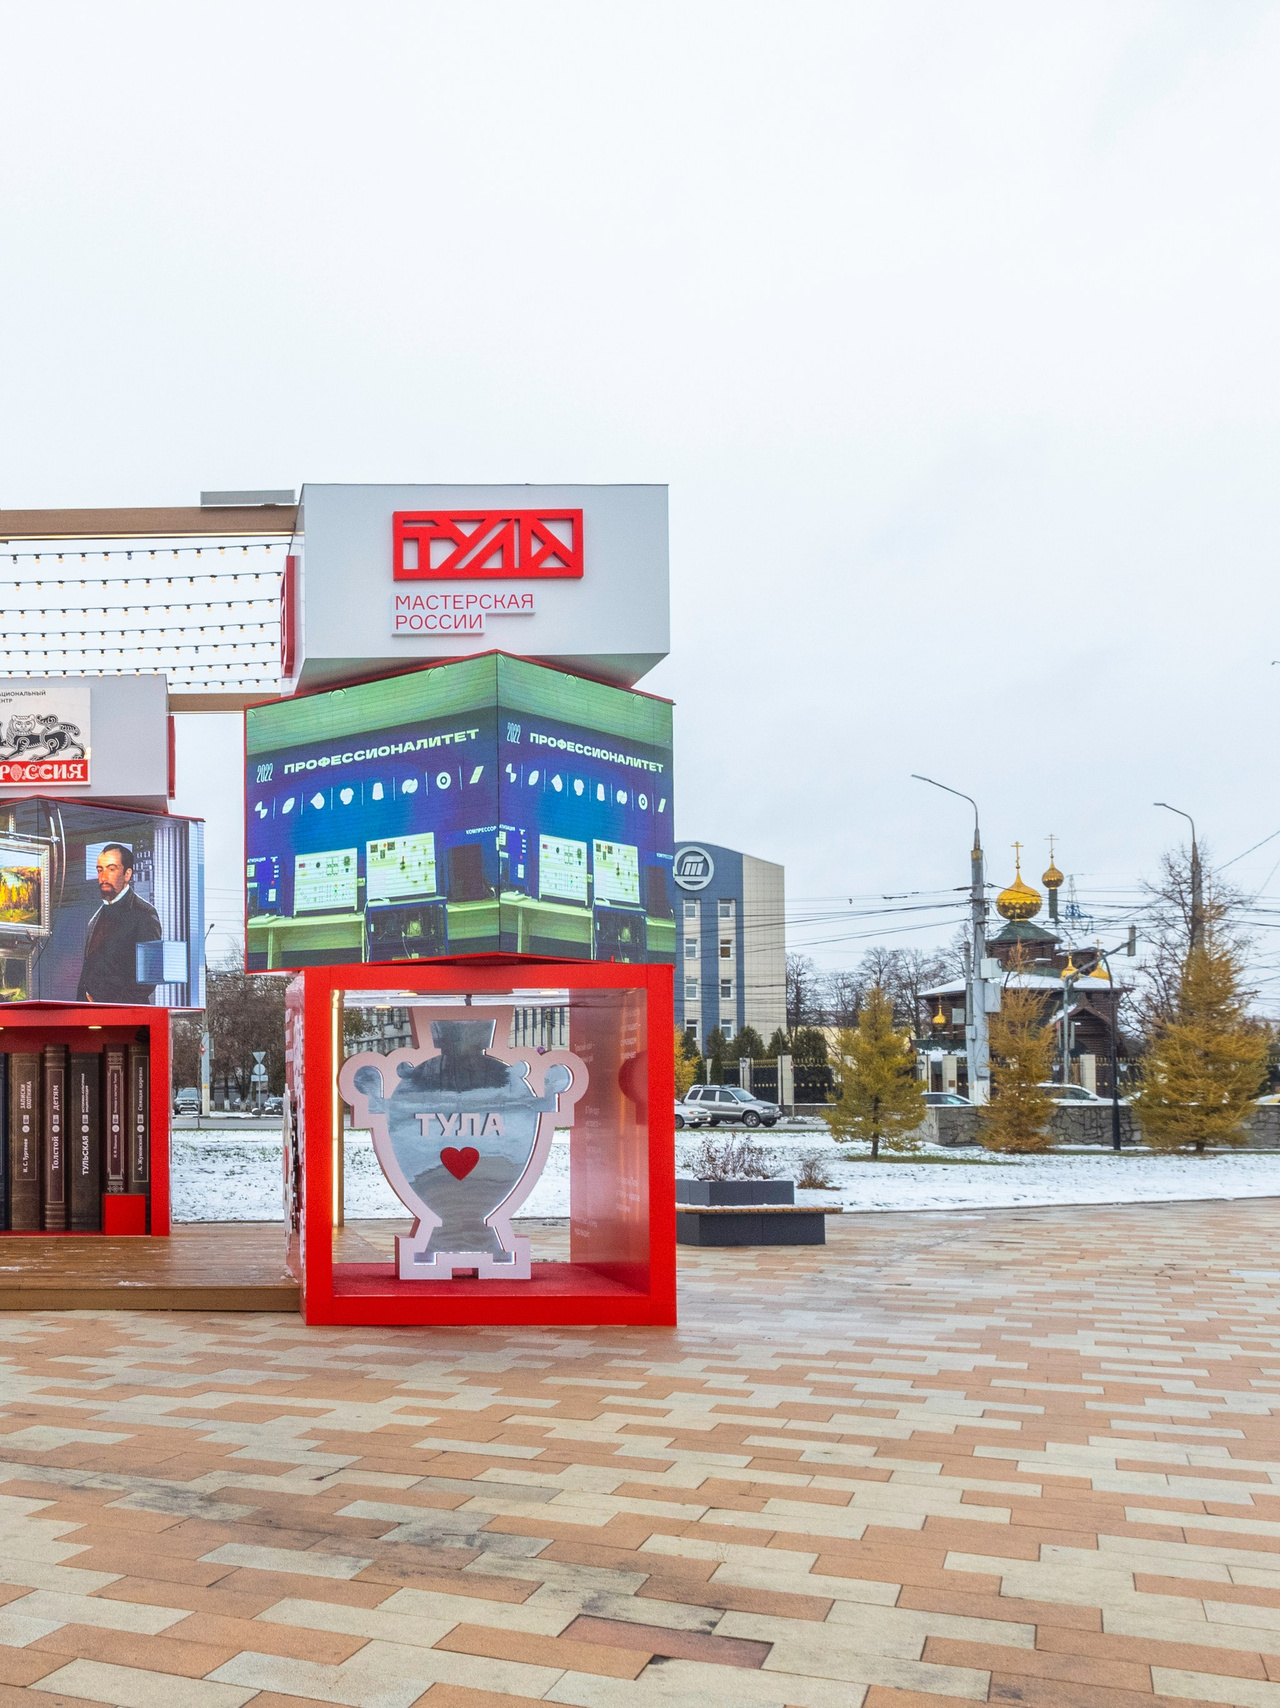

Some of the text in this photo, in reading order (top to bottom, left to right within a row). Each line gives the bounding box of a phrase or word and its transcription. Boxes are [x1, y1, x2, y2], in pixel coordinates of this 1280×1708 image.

[395, 593, 534, 611] МАСТЕРСКАЯ
[395, 613, 483, 630] РОССИИ
[284, 728, 480, 775] ПРОФЕССИОНАЛИТЕТ
[530, 732, 664, 774] ПРОФЕССИОНАЛИТЕТ
[414, 1112, 504, 1137] ТУЛА
[51, 1136, 59, 1170] Толстой
